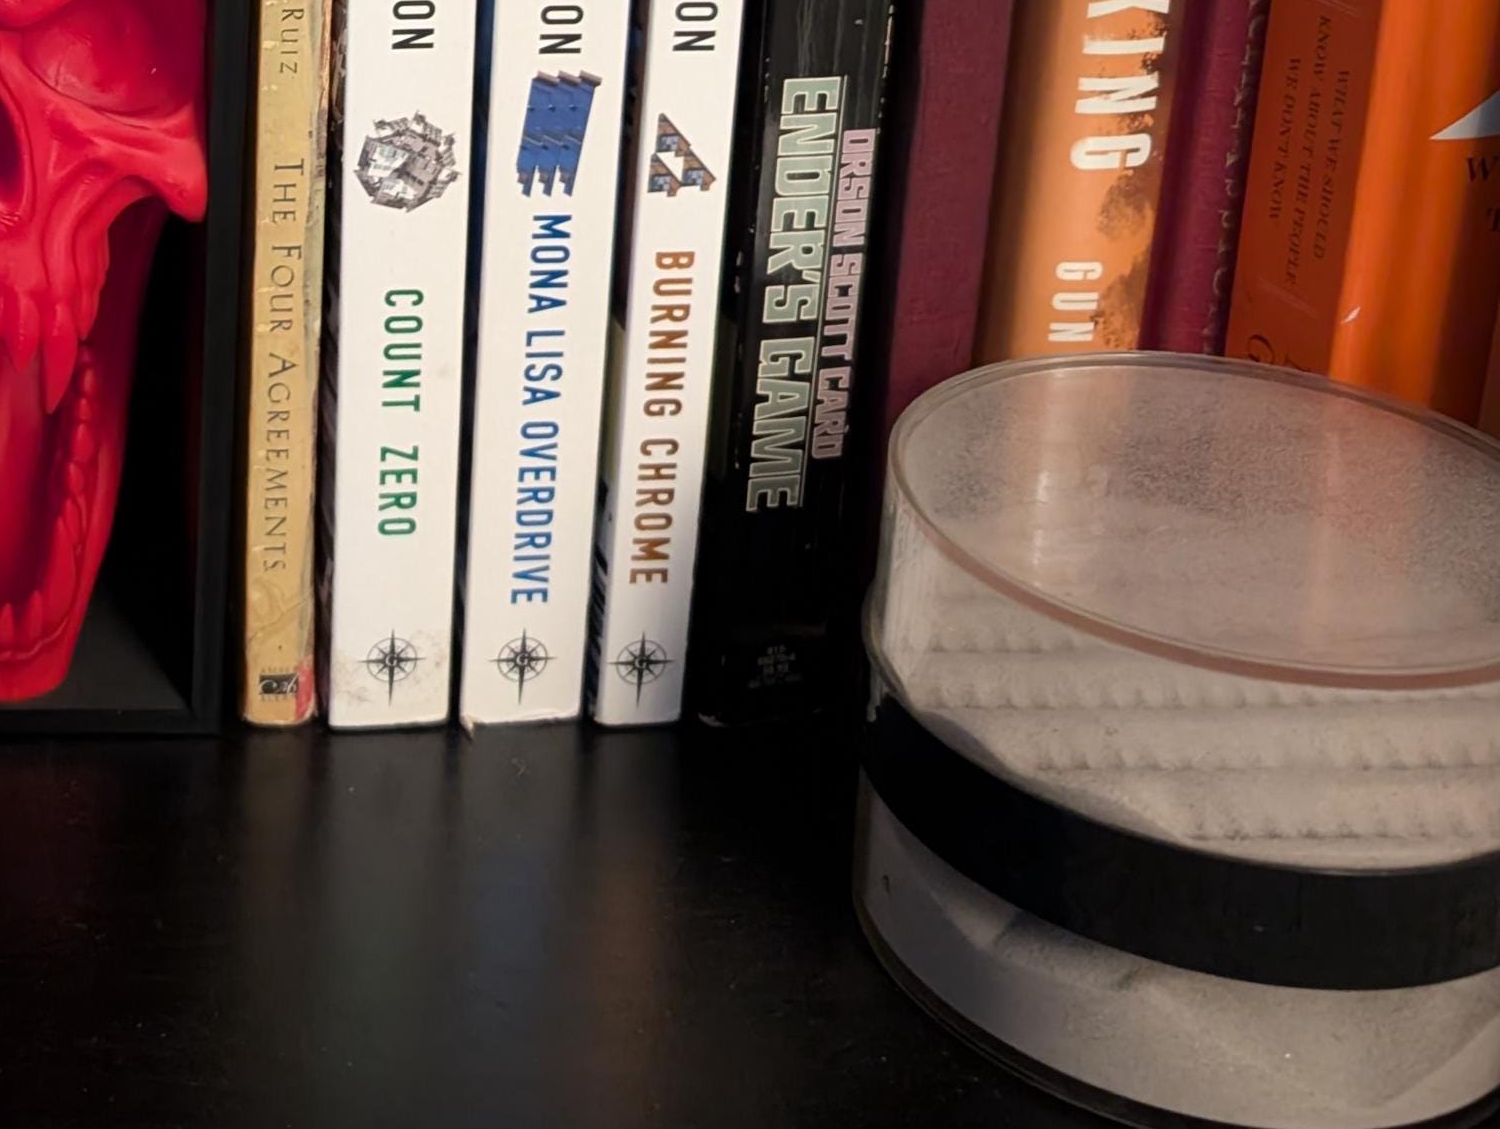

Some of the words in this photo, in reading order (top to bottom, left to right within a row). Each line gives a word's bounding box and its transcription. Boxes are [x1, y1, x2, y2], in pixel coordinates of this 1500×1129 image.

[279, 7, 305, 74] RUIZ
[1286, 57, 1301, 90] WE
[1313, 15, 1332, 82] KNOW
[1302, 92, 1322, 158] ABOUT
[1331, 70, 1351, 132] WHAT
[272, 158, 304, 224] THE
[762, 74, 842, 324] ENDER'S
[832, 127, 878, 248] ORSON
[1268, 161, 1288, 223] KNOW
[1296, 163, 1312, 204] THE
[1327, 139, 1341, 172] WE
[1285, 207, 1305, 285] PEOPLE
[1314, 175, 1334, 260] SHOULD
[269, 244, 302, 332] FOUR
[527, 213, 572, 315] MONA
[823, 252, 865, 360] SCOTT
[382, 288, 424, 412] COUNT
[522, 329, 565, 407] LISA
[643, 250, 696, 418] BURNING
[746, 336, 815, 512] GAME
[812, 366, 852, 459] CARD
[262, 351, 298, 572] AGREEMENTS
[378, 445, 419, 537] ZERO
[511, 421, 560, 605] OVERDRIVE
[629, 438, 679, 585] CHROME
